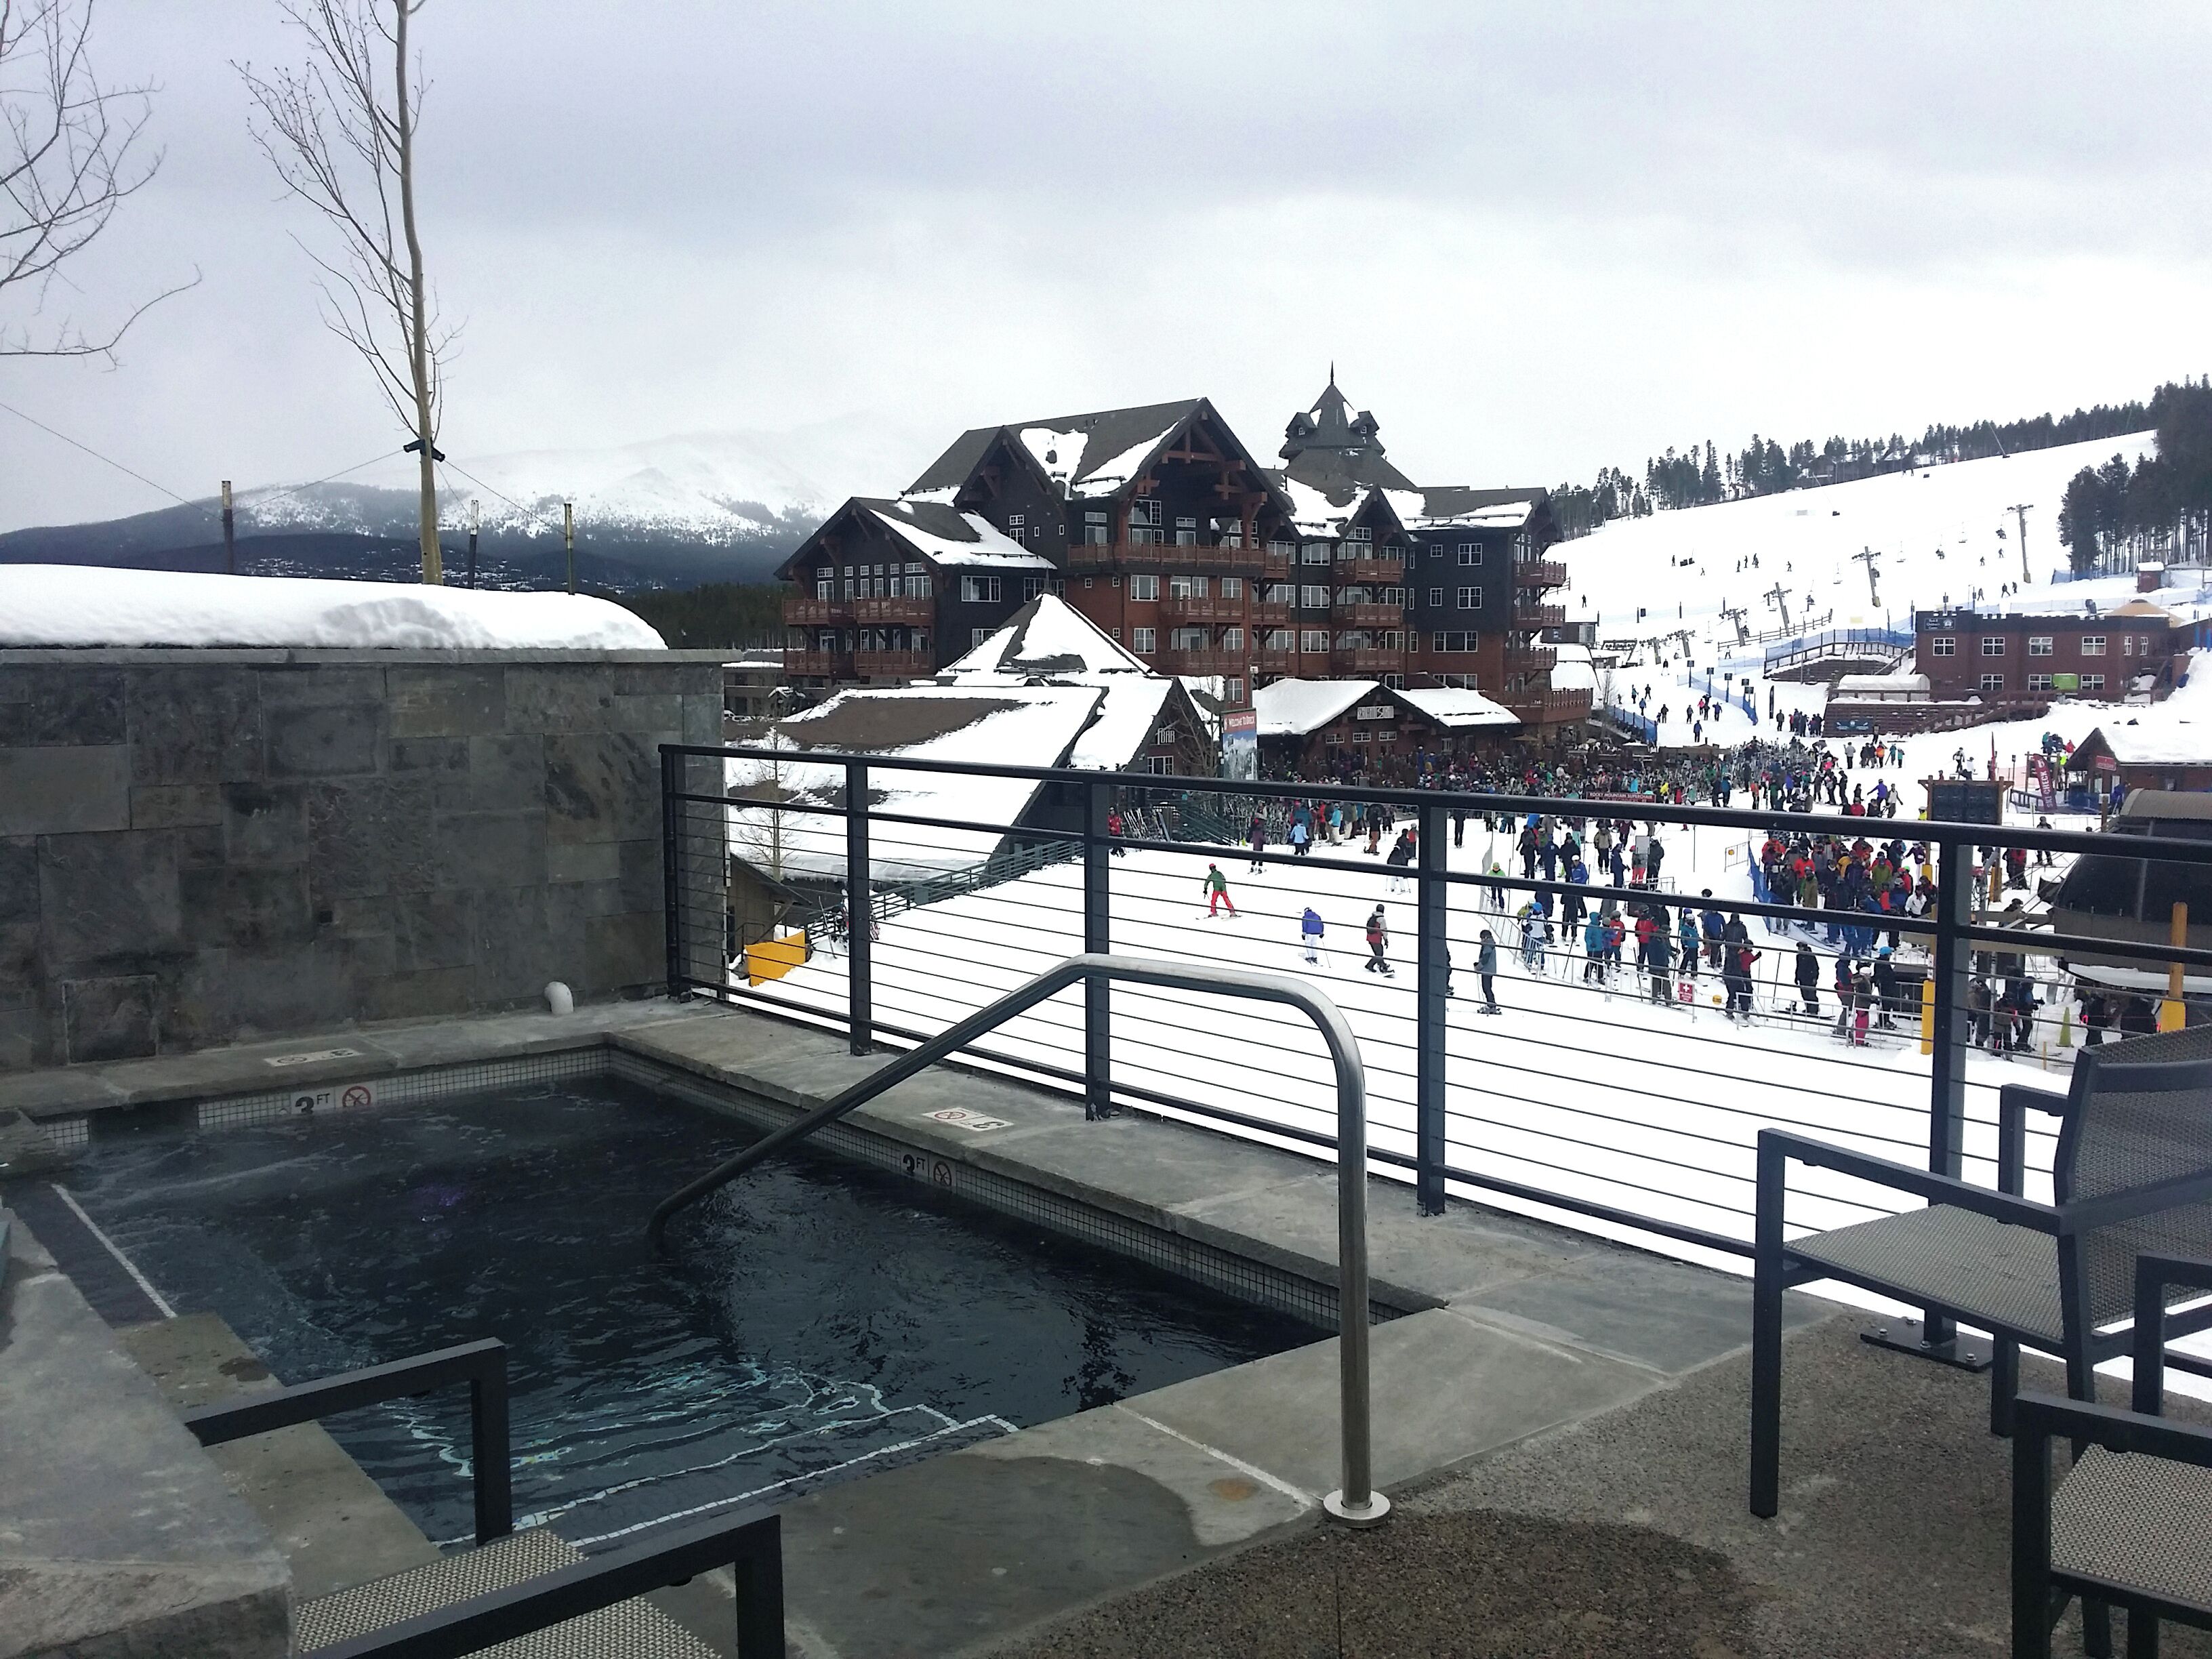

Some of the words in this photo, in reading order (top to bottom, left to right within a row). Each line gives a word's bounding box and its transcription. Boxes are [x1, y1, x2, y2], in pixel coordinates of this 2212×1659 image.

[2040, 771, 2051, 794] CHECK
[295, 1096, 314, 1113] 3
[316, 1093, 330, 1105] FT
[916, 1156, 926, 1170] FT
